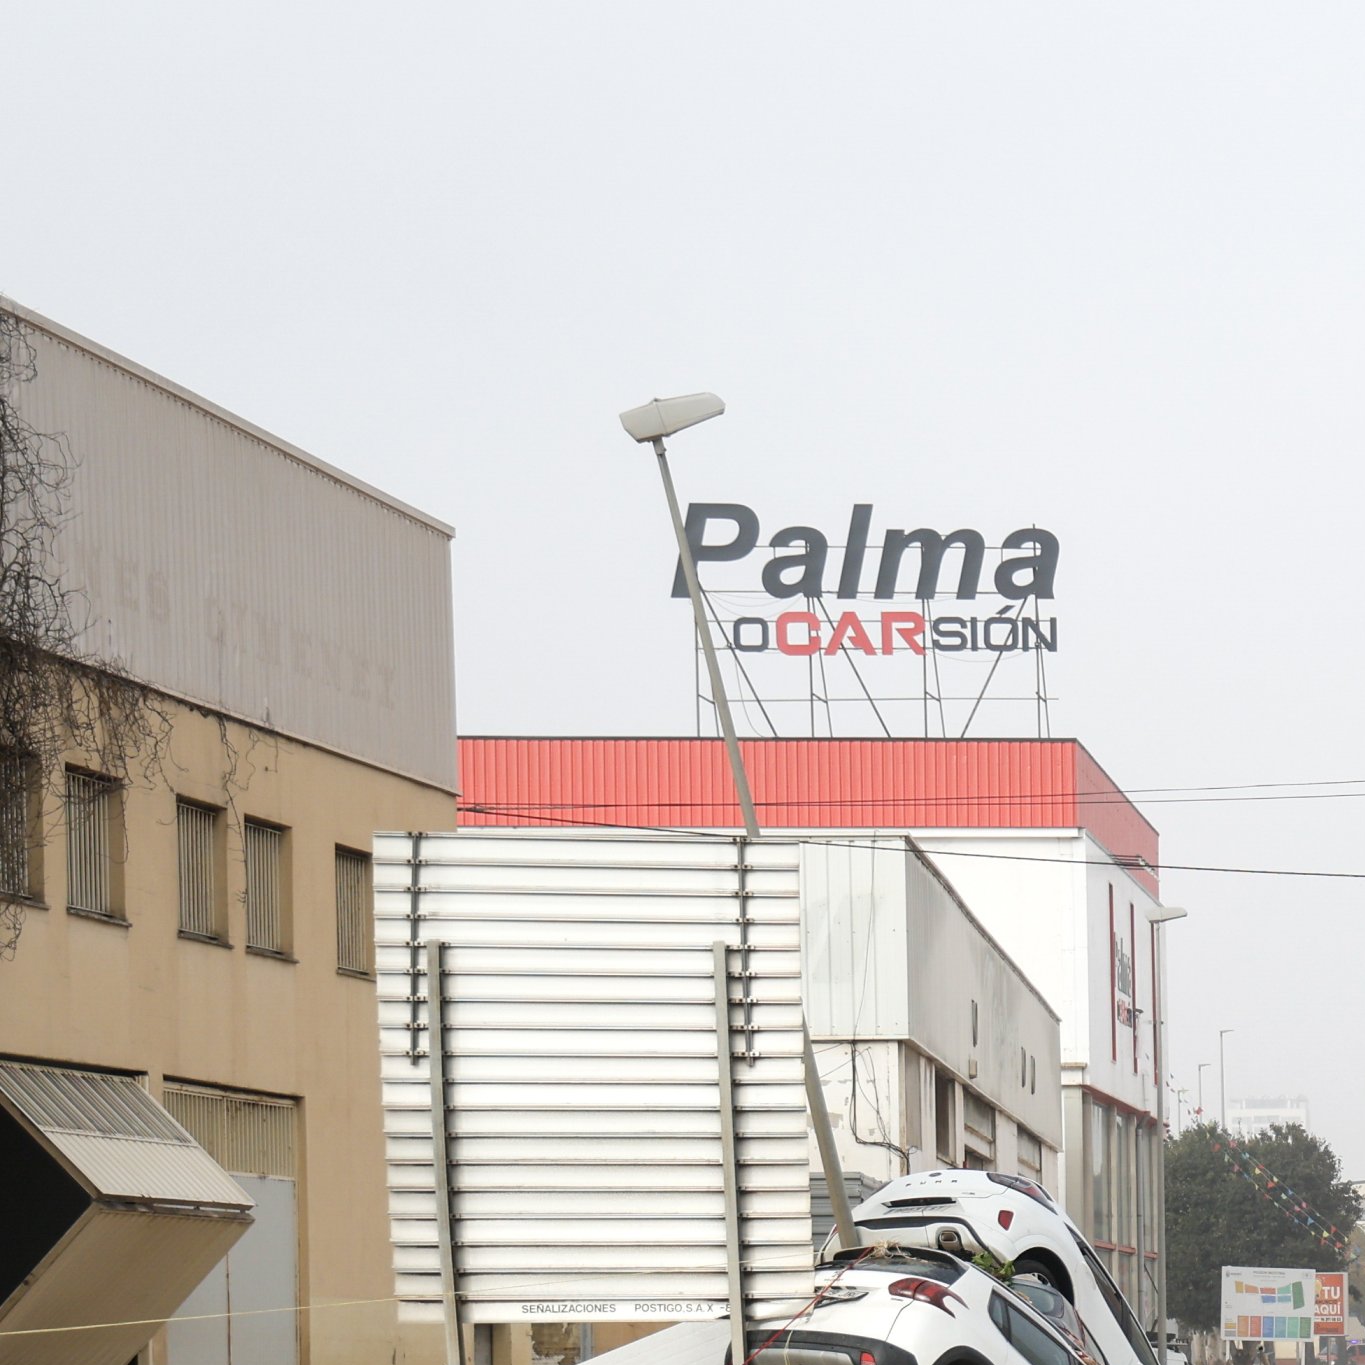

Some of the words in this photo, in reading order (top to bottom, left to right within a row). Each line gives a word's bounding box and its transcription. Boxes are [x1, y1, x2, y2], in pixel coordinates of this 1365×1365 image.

[671, 502, 1060, 600] Palma
[1322, 1286, 1340, 1299] TU
[521, 1303, 616, 1314] SEÑALIZACIONES
[1314, 1302, 1341, 1314] AQUÍ
